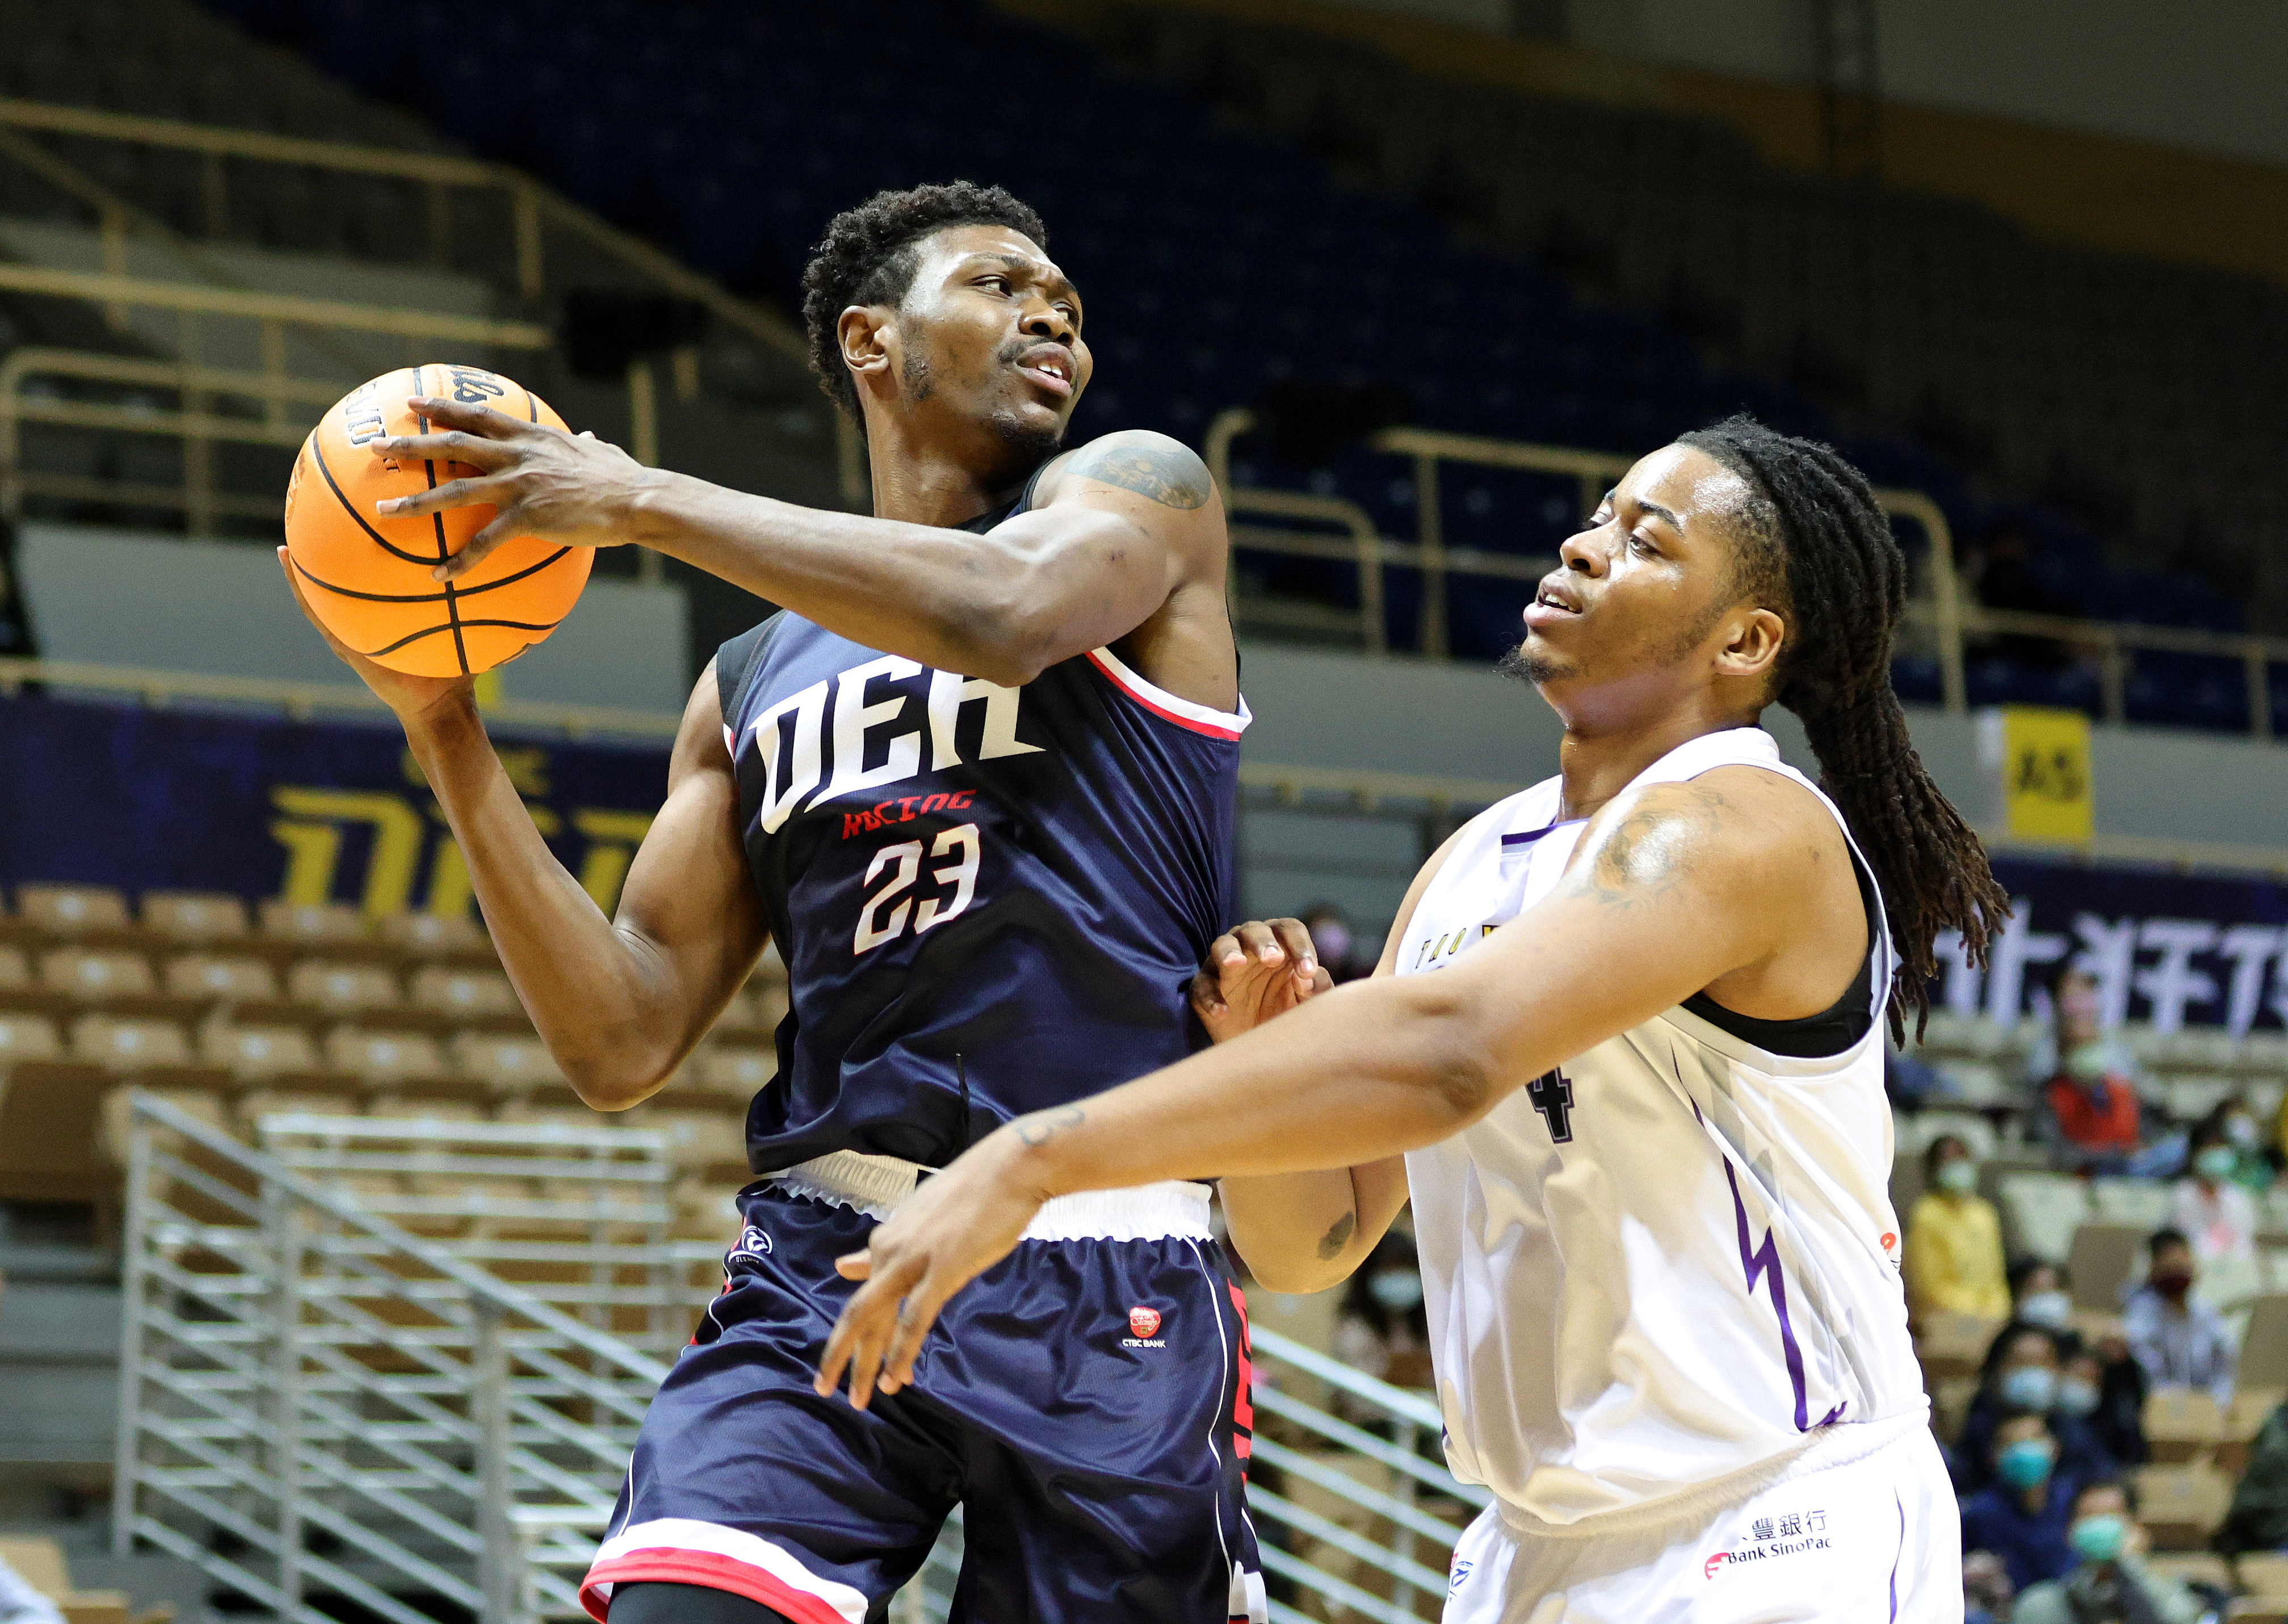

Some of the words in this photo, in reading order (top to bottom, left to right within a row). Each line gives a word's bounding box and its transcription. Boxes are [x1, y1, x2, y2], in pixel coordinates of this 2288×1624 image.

[854, 823, 981, 956] 23
[1122, 1338, 1143, 1348] CTBC
[1143, 1340, 1166, 1348] BANK
[1742, 1510, 1827, 1541] 豐銀行
[1728, 1547, 1767, 1564] Bank
[1770, 1538, 1832, 1557] SinoPac
